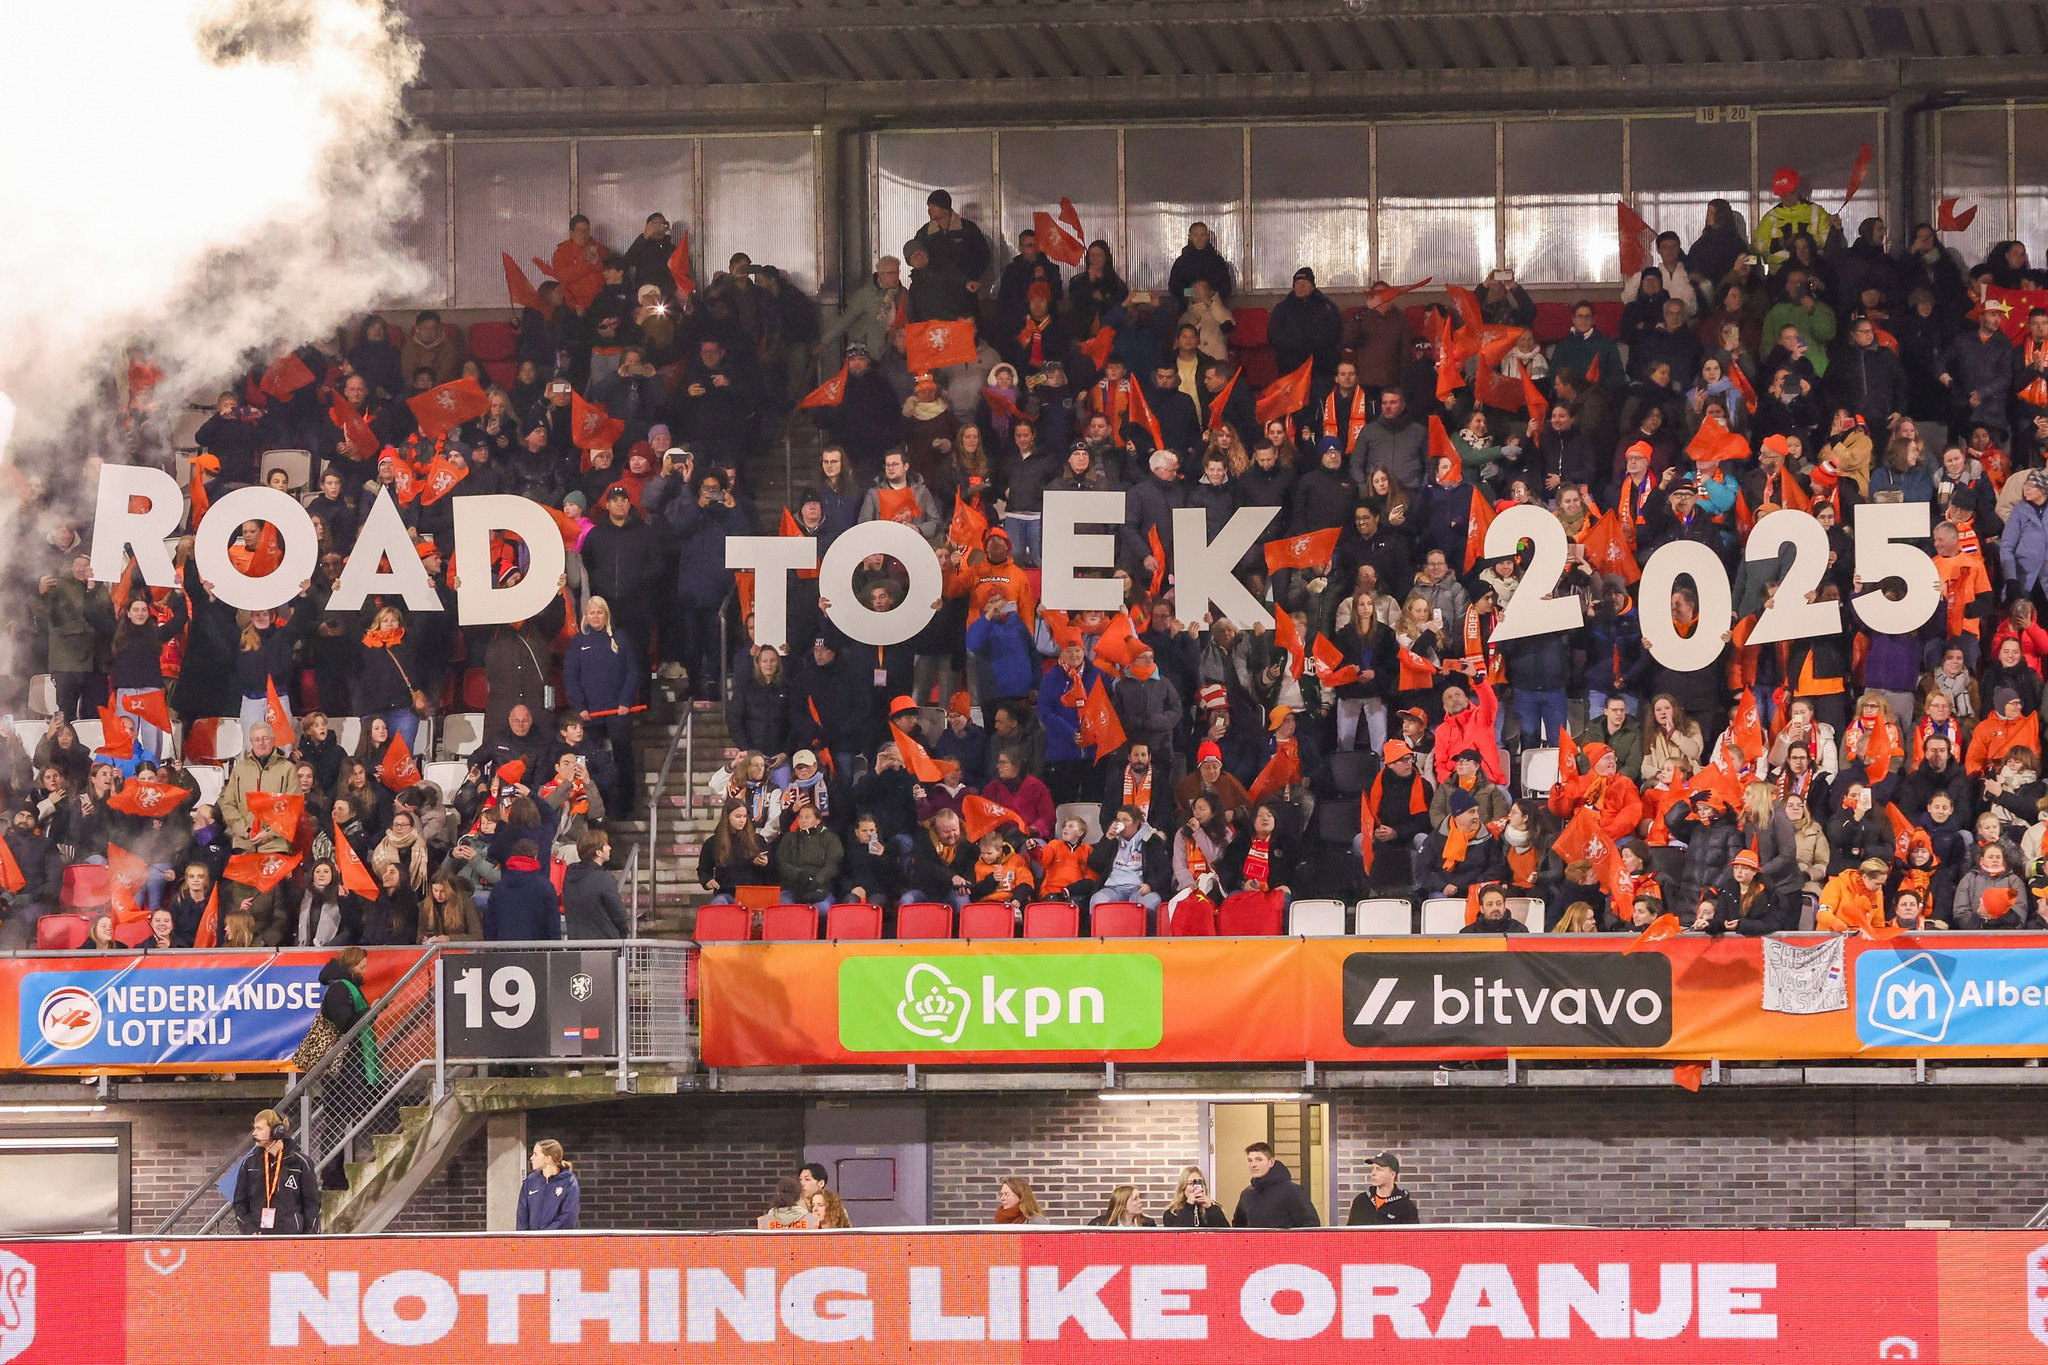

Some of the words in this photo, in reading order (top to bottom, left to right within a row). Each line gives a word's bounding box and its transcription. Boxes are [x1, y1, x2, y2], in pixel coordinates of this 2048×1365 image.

[90, 463, 566, 626] ROAD
[725, 520, 943, 656] TO
[1041, 491, 1283, 632] EK
[1484, 502, 1941, 672] 2025
[106, 982, 322, 1013] NEDERLANDSE
[453, 965, 536, 1029] 19
[983, 976, 1105, 1037] kpn
[1434, 975, 1662, 1025] bitvavo
[106, 1017, 231, 1047] LOTERIJ
[268, 1266, 876, 1347] NOTHING
[907, 1264, 1209, 1342] LIKE
[1239, 1263, 1779, 1341] ORANJE
